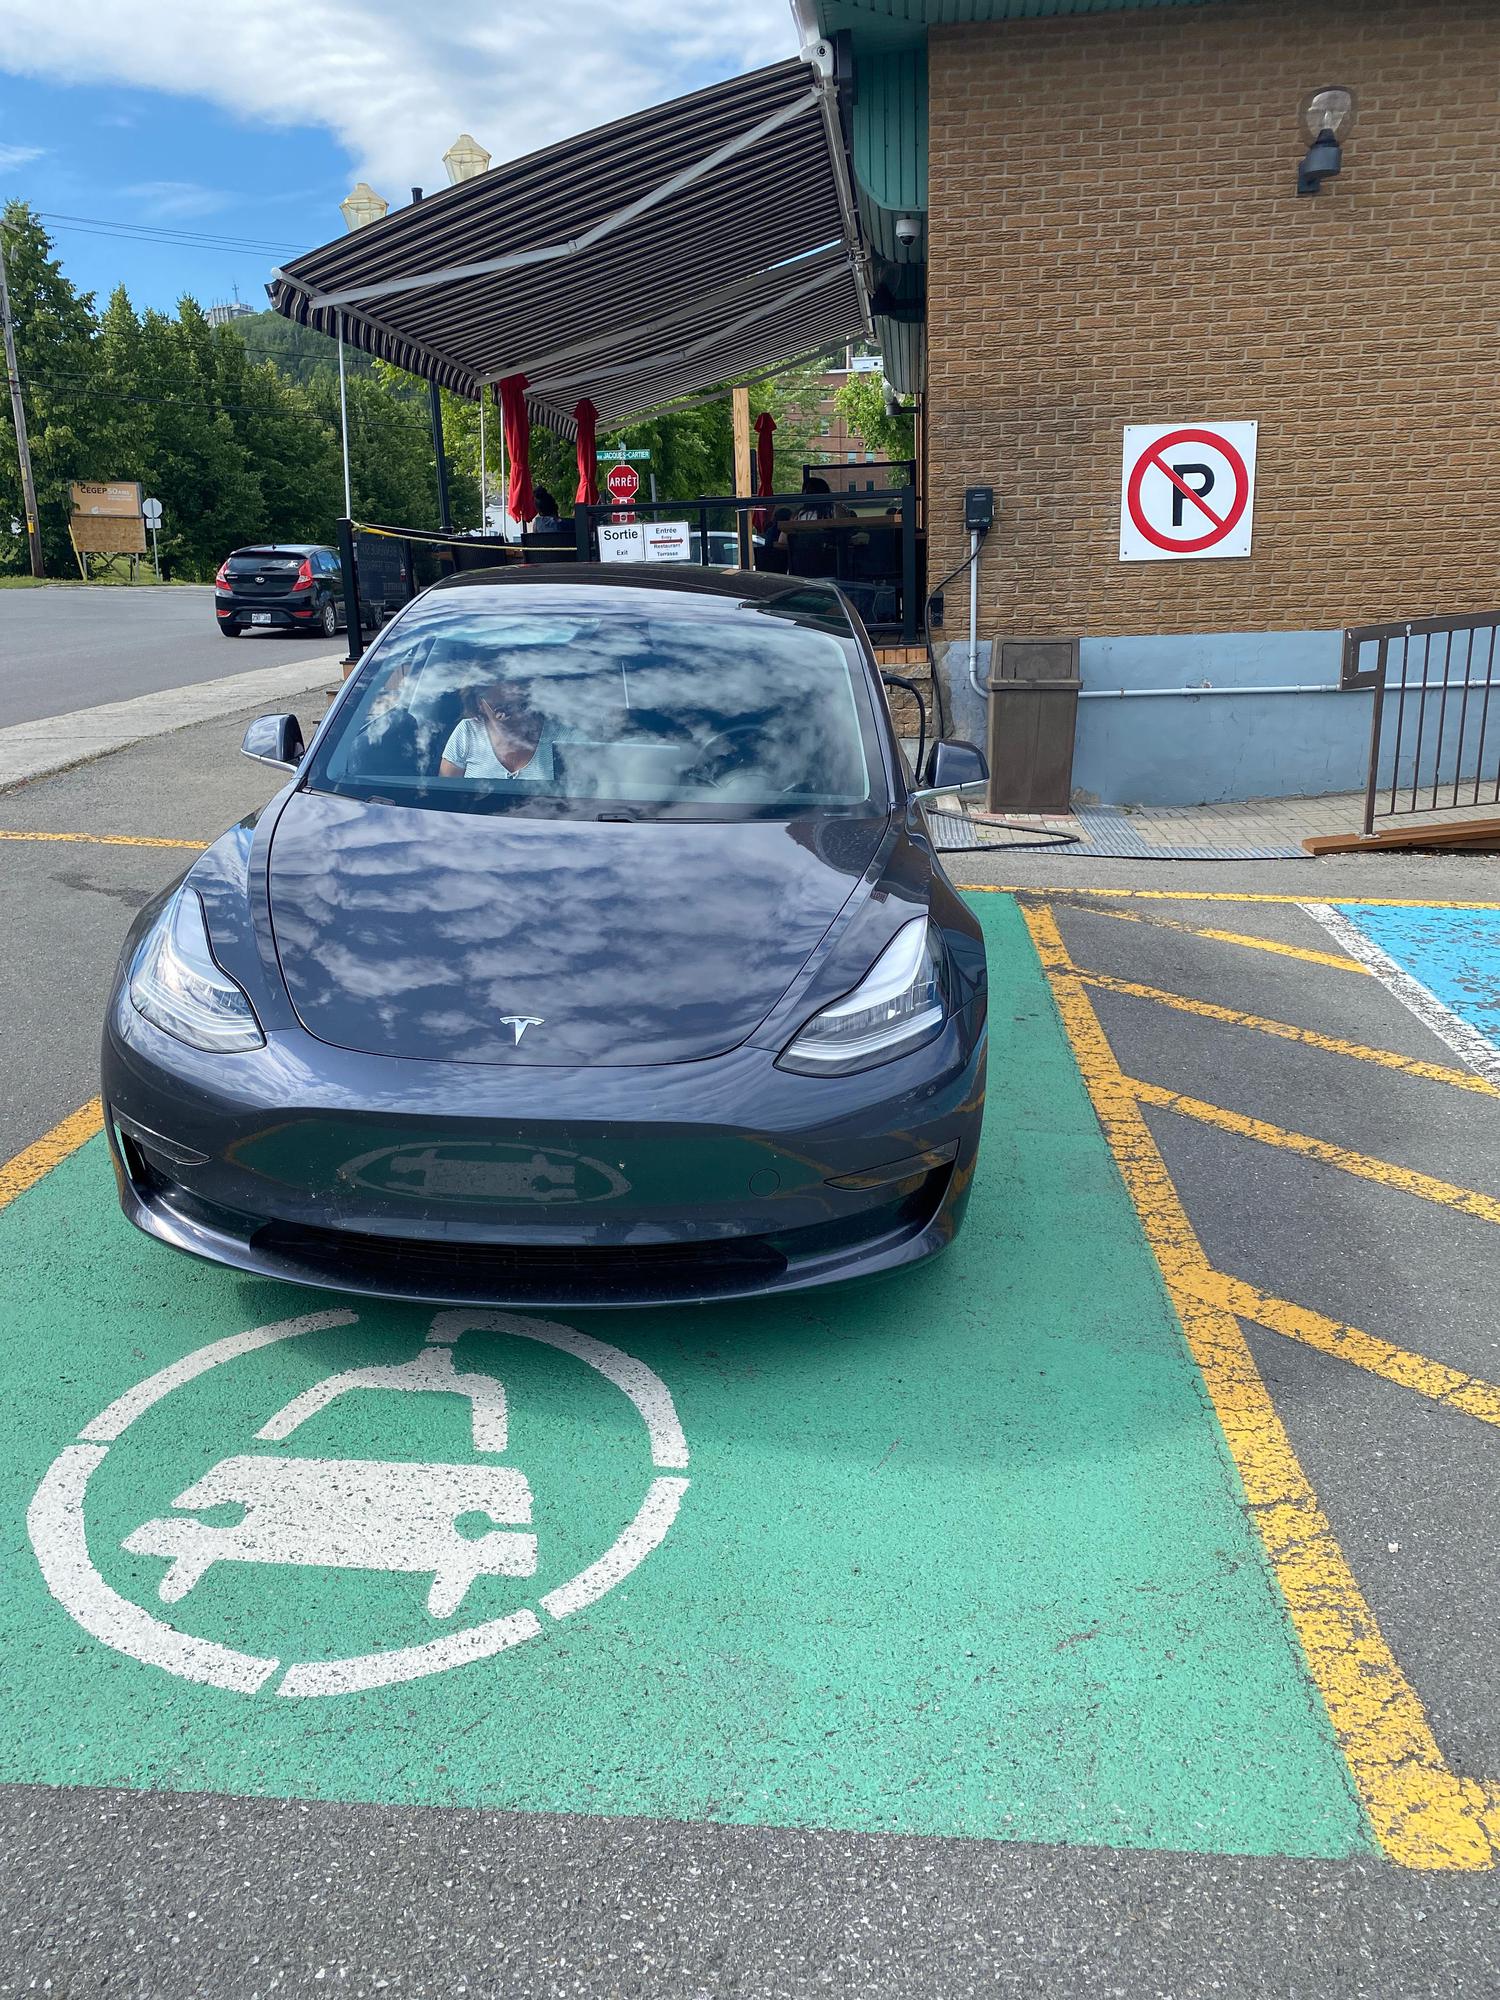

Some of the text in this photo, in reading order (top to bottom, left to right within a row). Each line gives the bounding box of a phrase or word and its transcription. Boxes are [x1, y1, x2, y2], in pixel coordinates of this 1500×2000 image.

[603, 451, 650, 459] JACQUES-CARTIER
[610, 475, 637, 487] ARRÊT
[1172, 463, 1215, 527] P
[604, 528, 638, 541] Sortie
[655, 527, 677, 535] Entrée
